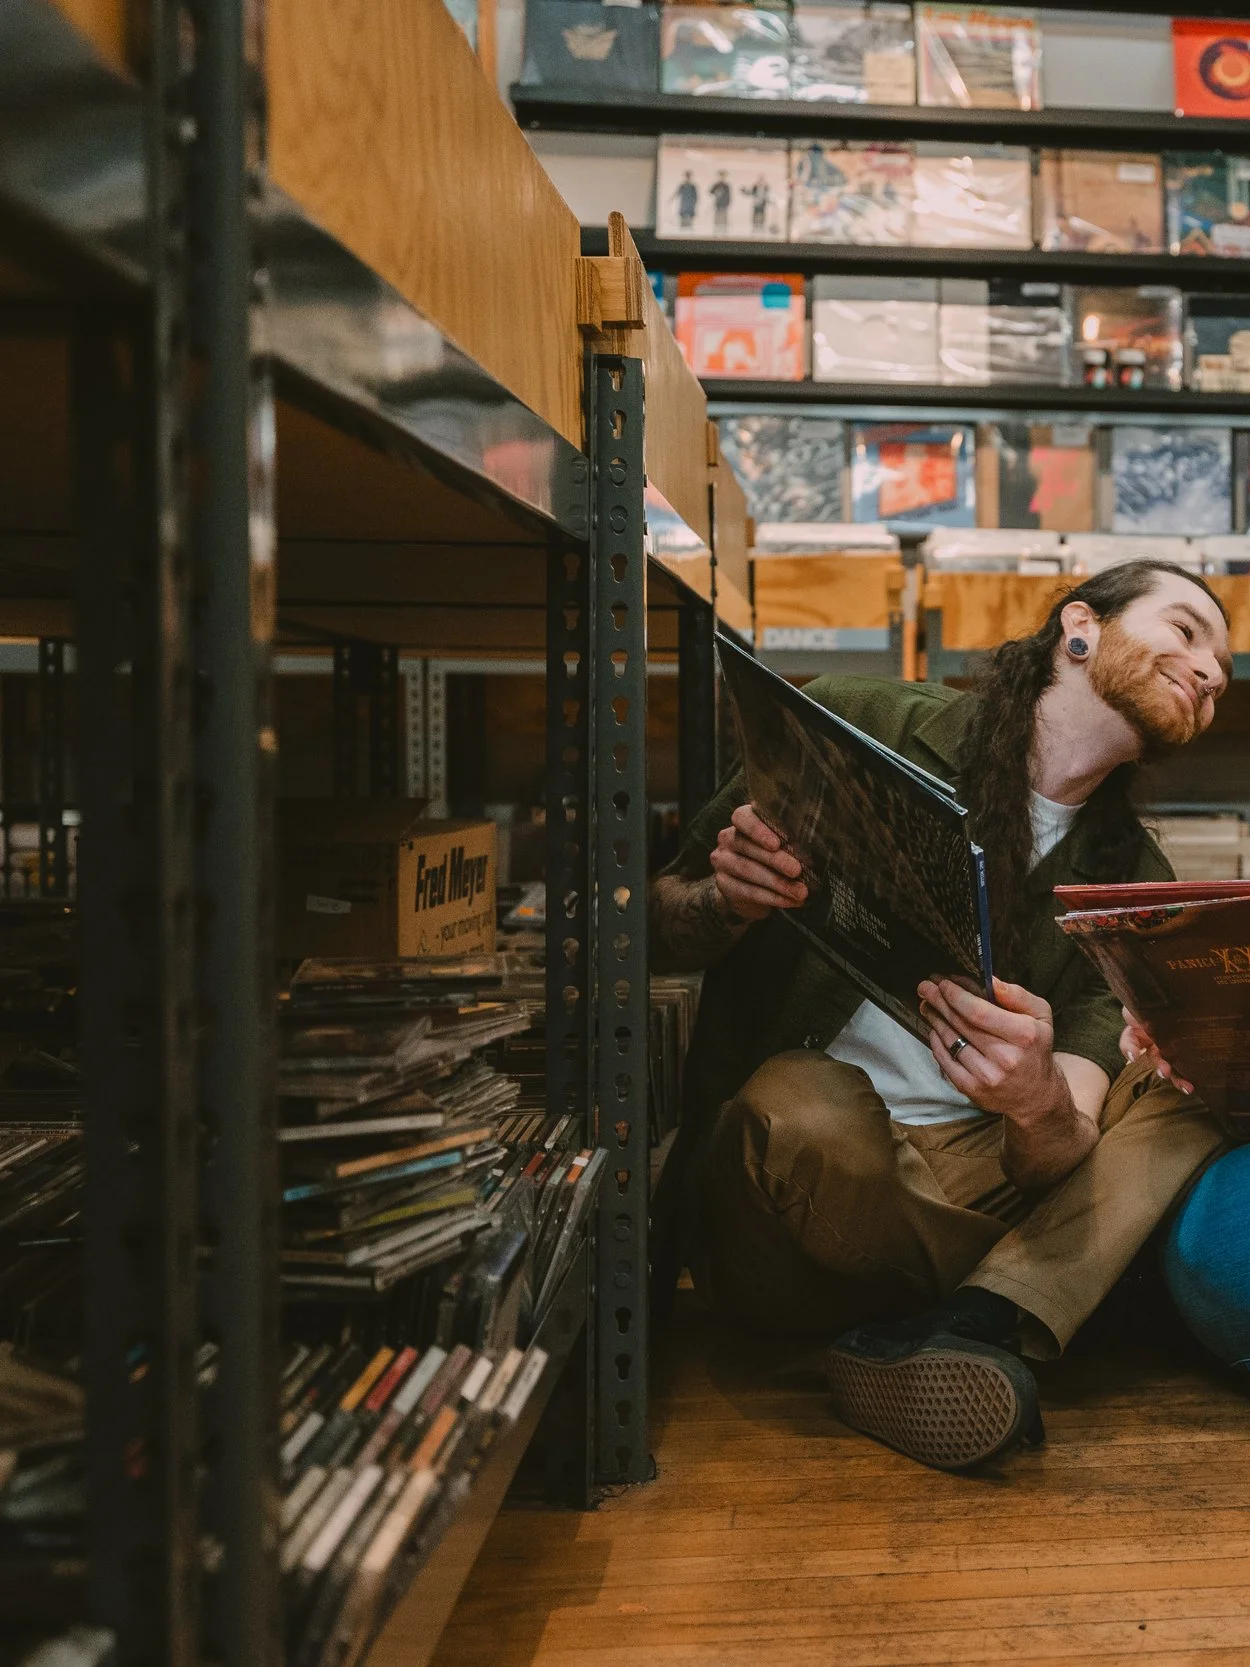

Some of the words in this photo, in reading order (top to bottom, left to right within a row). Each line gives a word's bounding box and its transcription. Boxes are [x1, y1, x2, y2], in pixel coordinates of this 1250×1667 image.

[765, 629, 837, 650] DANCE
[415, 854, 448, 912] Fred
[448, 846, 488, 906] Meyer
